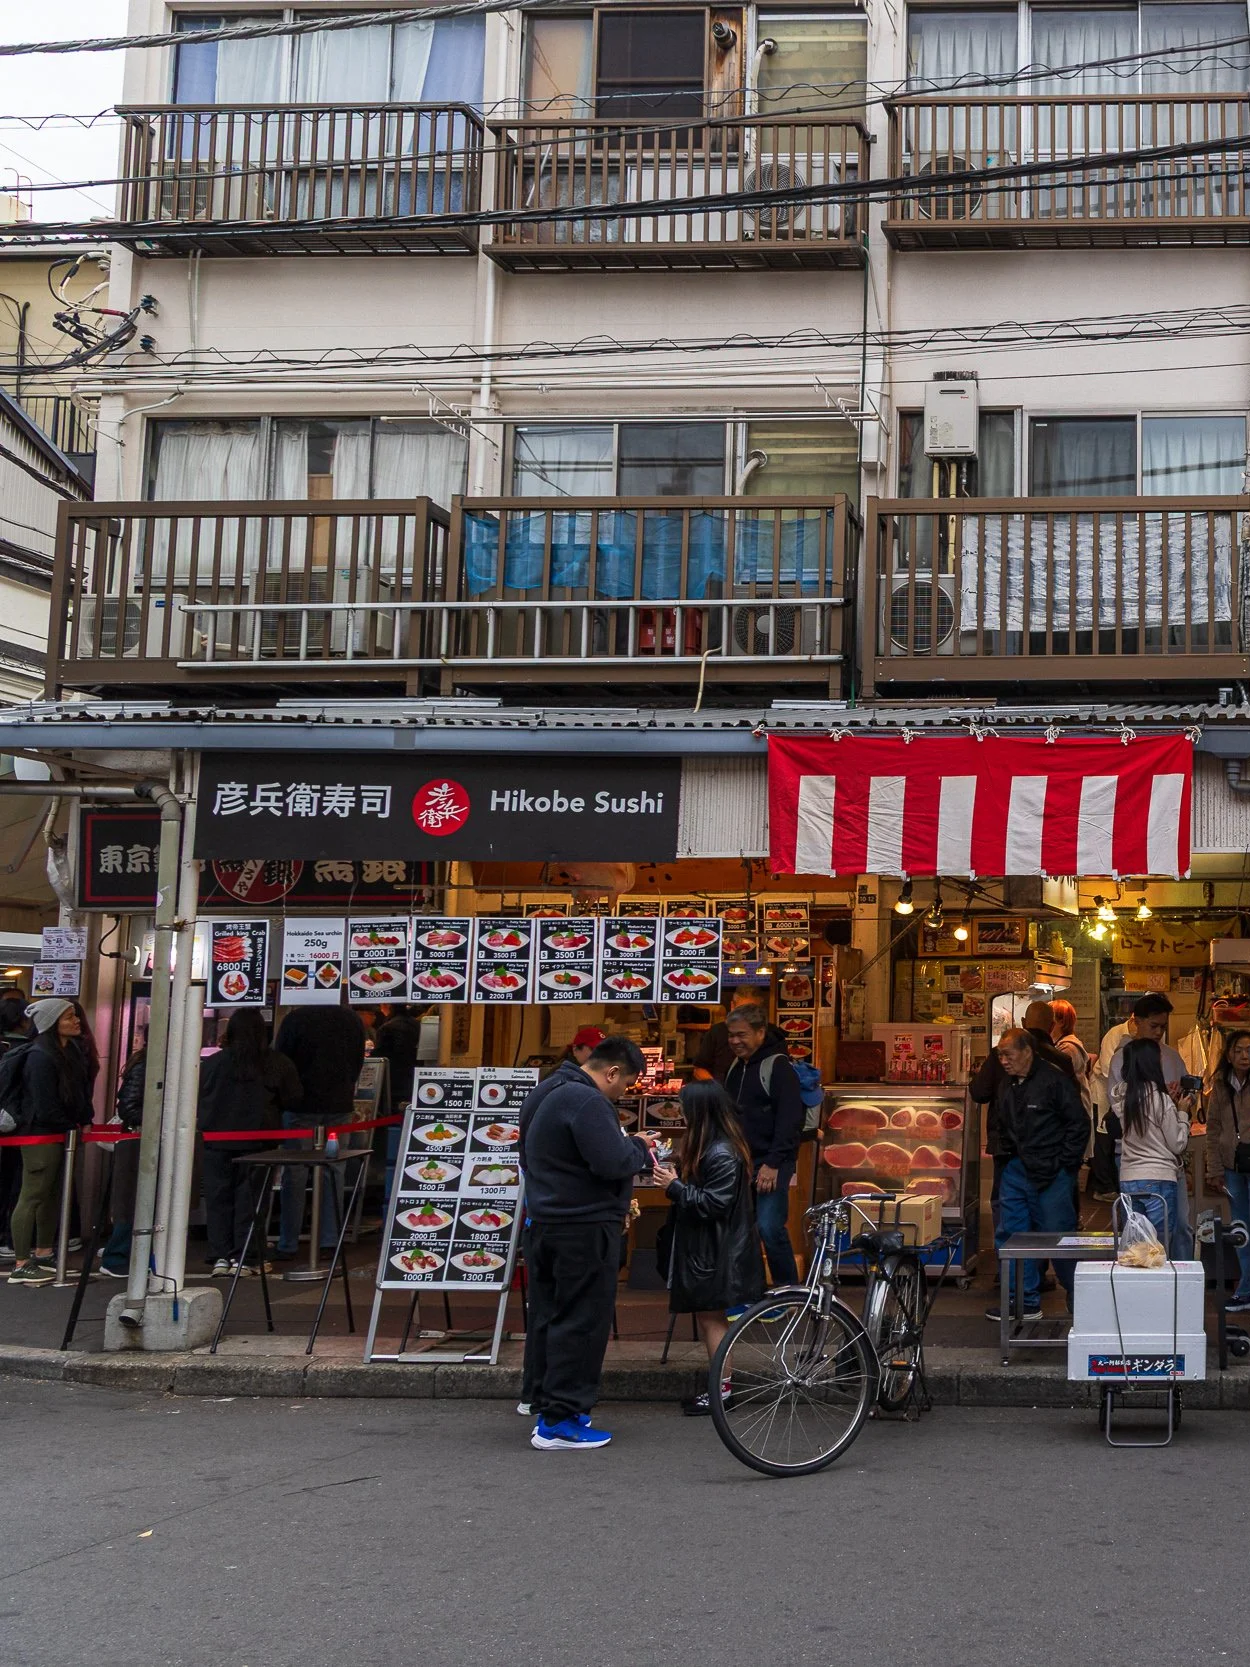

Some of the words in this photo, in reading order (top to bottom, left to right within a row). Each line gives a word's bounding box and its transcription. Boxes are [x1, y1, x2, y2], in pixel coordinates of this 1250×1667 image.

[212, 781, 392, 818] 彦兵衛寿司
[490, 790, 585, 813] Hikobe
[594, 791, 664, 814] Sushi
[99, 844, 160, 874] 東京
[304, 939, 328, 948] 250g
[364, 949, 395, 957] 6000円
[217, 963, 251, 971] 6800円
[675, 992, 706, 1000] 1400円
[444, 1100, 472, 1108] 1500円
[470, 1233, 500, 1241] 1800円
[1132, 1359, 1174, 1372] ギンダラ
